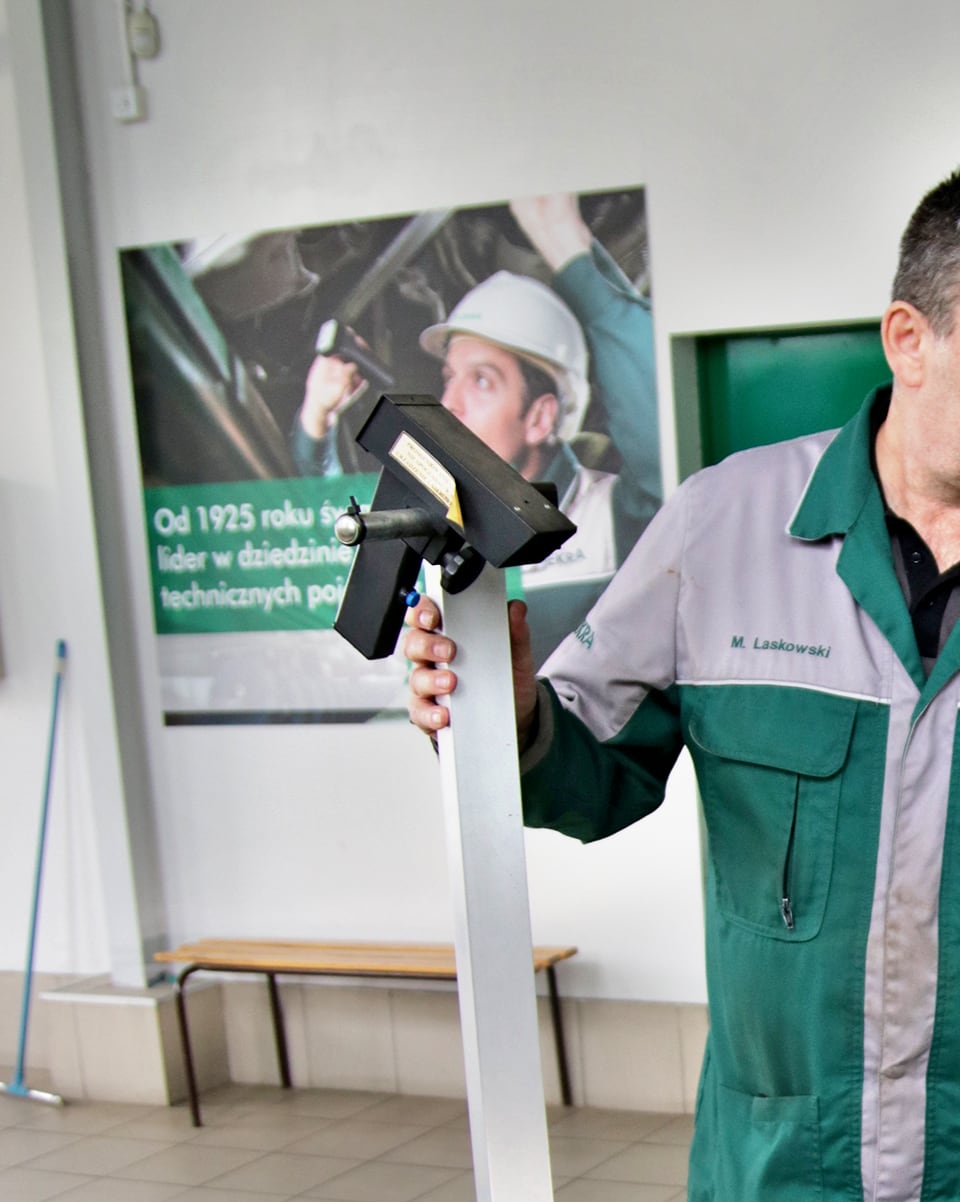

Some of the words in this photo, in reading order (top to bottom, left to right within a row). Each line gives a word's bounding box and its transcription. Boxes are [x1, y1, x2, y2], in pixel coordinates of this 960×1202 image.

[154, 507, 190, 535] Od
[197, 503, 254, 532] 1925
[260, 500, 313, 528] roku
[157, 545, 206, 572] lider
[212, 551, 232, 567] w
[237, 538, 352, 568] dziedzinie
[160, 577, 301, 612] technicznych
[731, 635, 745, 648] M.
[753, 637, 832, 658] Laskowski
